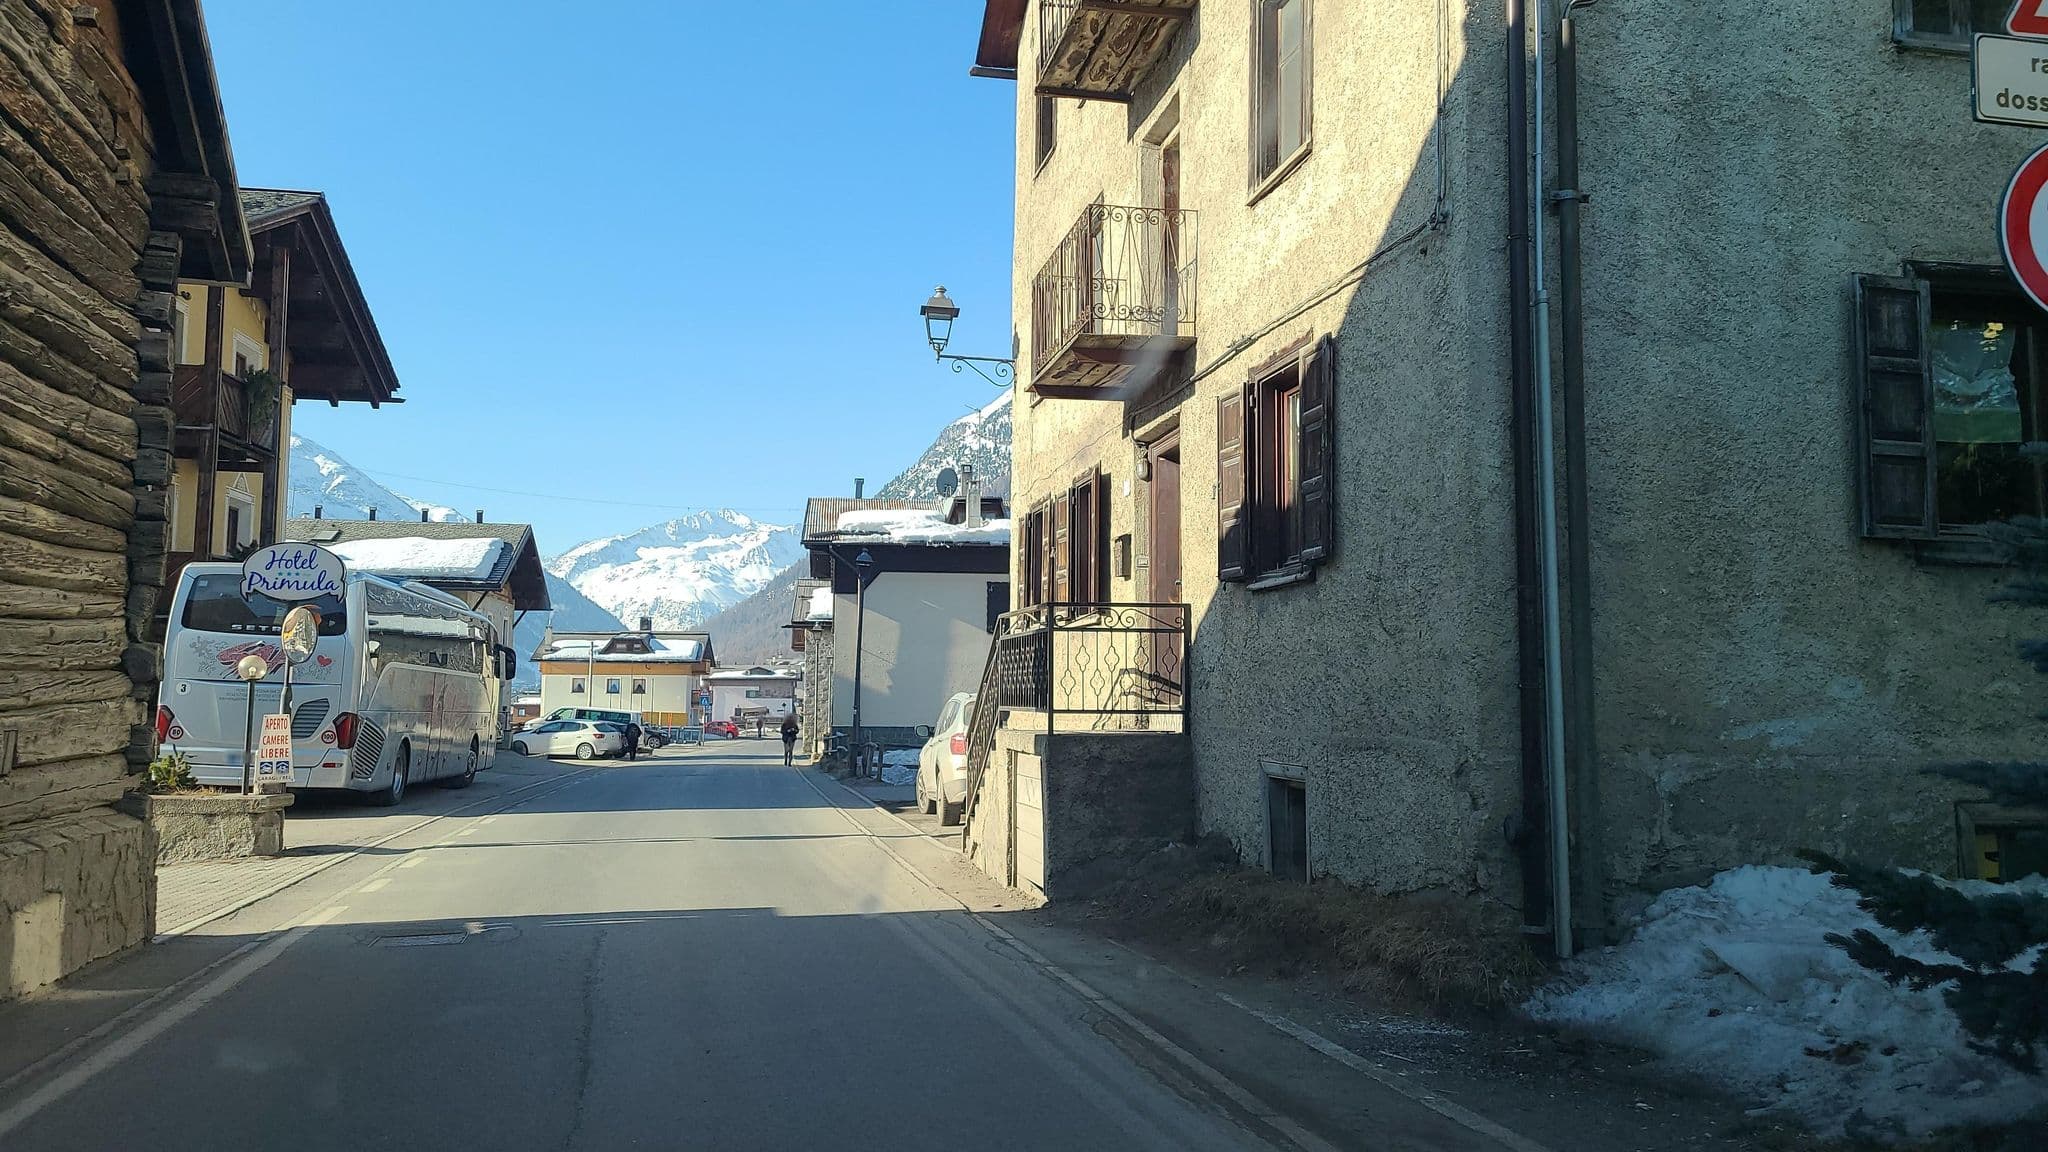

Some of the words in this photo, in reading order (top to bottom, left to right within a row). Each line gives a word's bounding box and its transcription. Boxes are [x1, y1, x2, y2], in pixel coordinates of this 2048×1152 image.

[265, 548, 319, 571] Hotel
[247, 569, 340, 591] Primula
[180, 683, 187, 693] 3
[264, 718, 289, 731] APERTO
[262, 734, 289, 746] CAMERE
[260, 747, 289, 759] LIBERE
